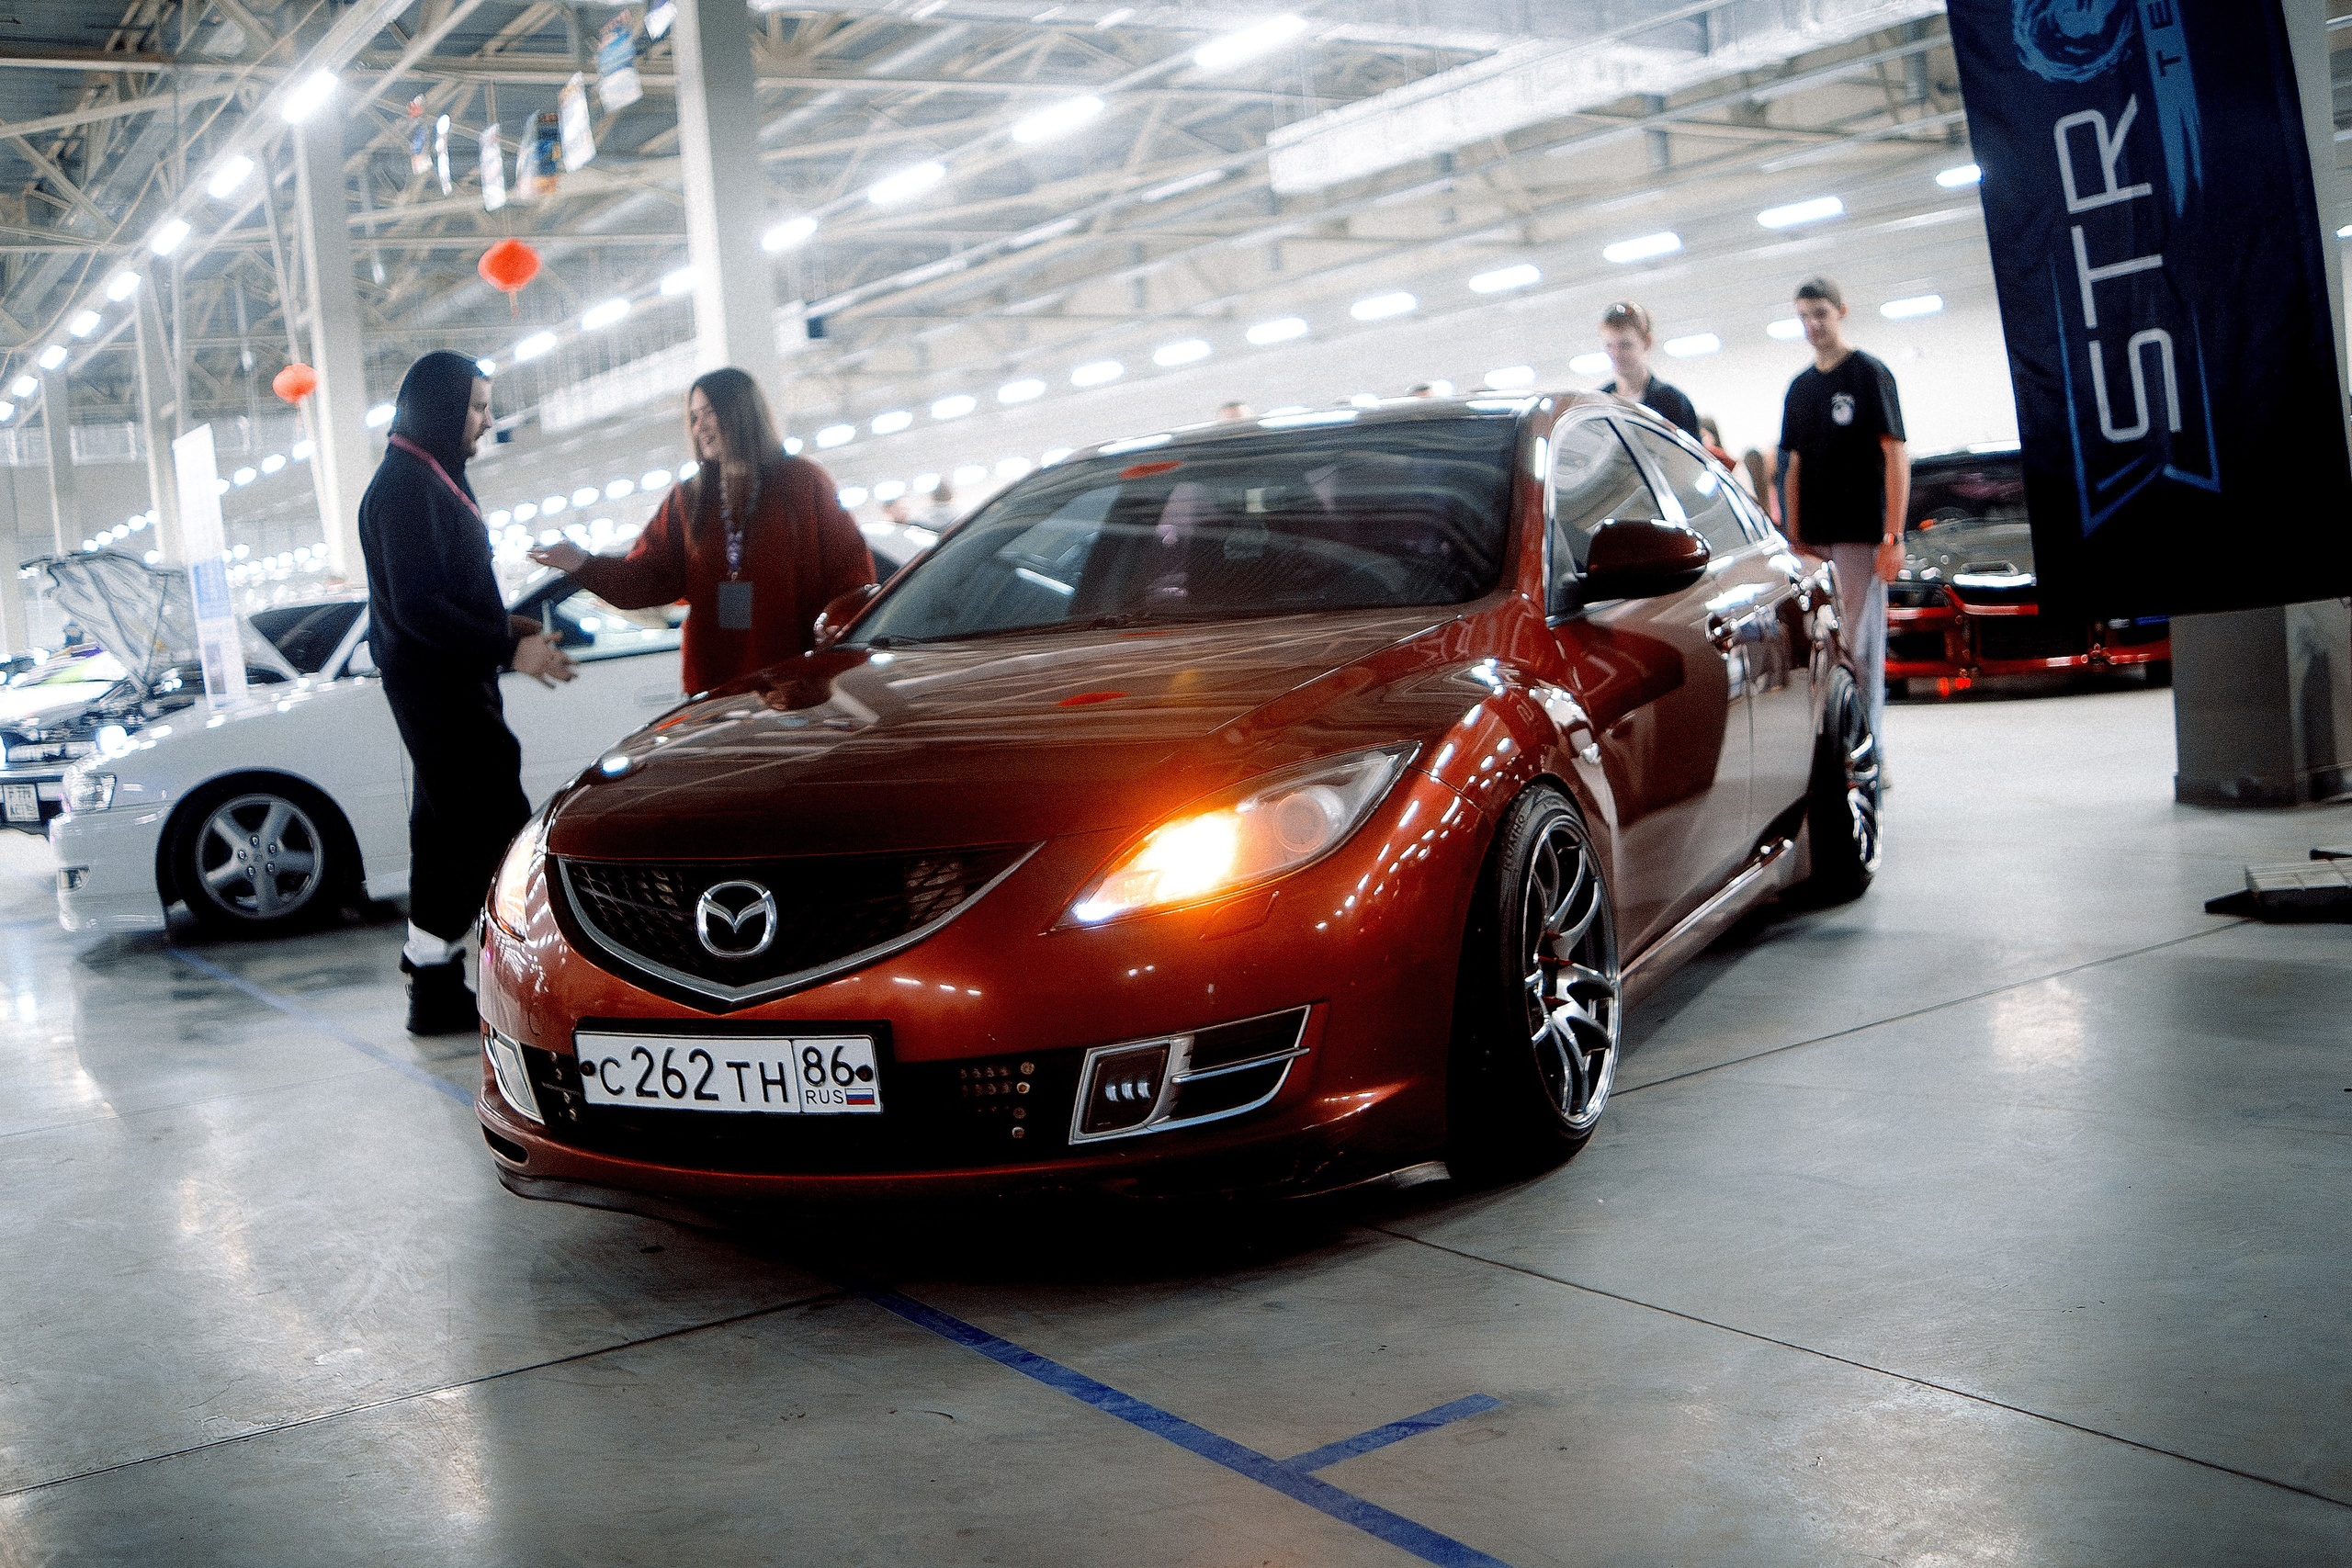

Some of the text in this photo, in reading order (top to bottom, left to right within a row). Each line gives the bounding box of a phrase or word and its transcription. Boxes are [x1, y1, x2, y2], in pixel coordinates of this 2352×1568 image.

[2053, 93, 2182, 443] STR
[802, 1045, 855, 1086] 86
[806, 1089, 843, 1104] RUS
